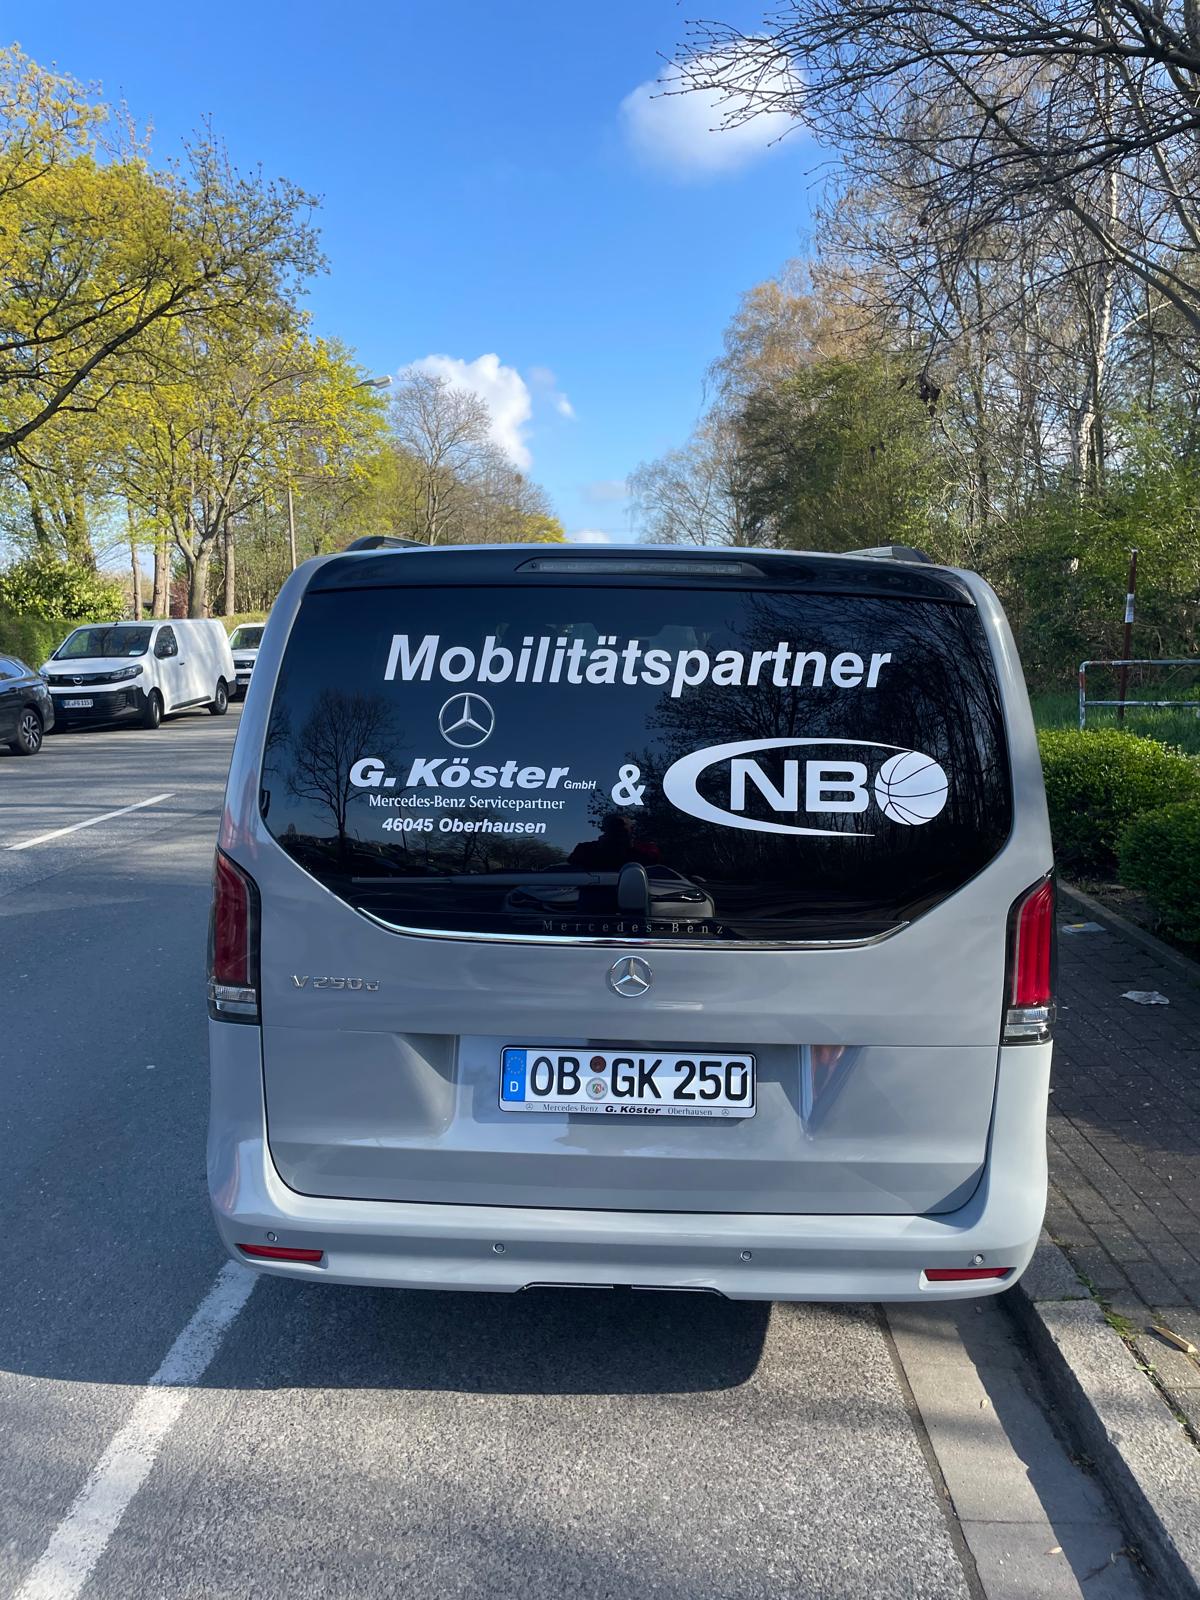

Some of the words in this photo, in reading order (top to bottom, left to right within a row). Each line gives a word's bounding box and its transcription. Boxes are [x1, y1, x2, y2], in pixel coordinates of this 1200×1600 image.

[384, 634, 892, 698] Mobilitätspartner
[349, 757, 396, 788] G.
[406, 757, 570, 789] Köster
[563, 780, 597, 790] GmbH
[611, 764, 646, 806] &
[368, 794, 466, 808] Mercedes-Benz
[469, 796, 566, 811] Servicepartner
[382, 817, 434, 833] 46045
[439, 818, 547, 834] Oberhausen
[542, 920, 724, 934] Mercedes-Benz
[510, 1081, 519, 1092] D
[530, 1056, 581, 1097] OB
[611, 1058, 663, 1099] GK
[673, 1060, 748, 1102] 250
[604, 1105, 617, 1113] G.
[620, 1105, 662, 1115] Köster
[667, 1107, 713, 1116] Oberhausen
